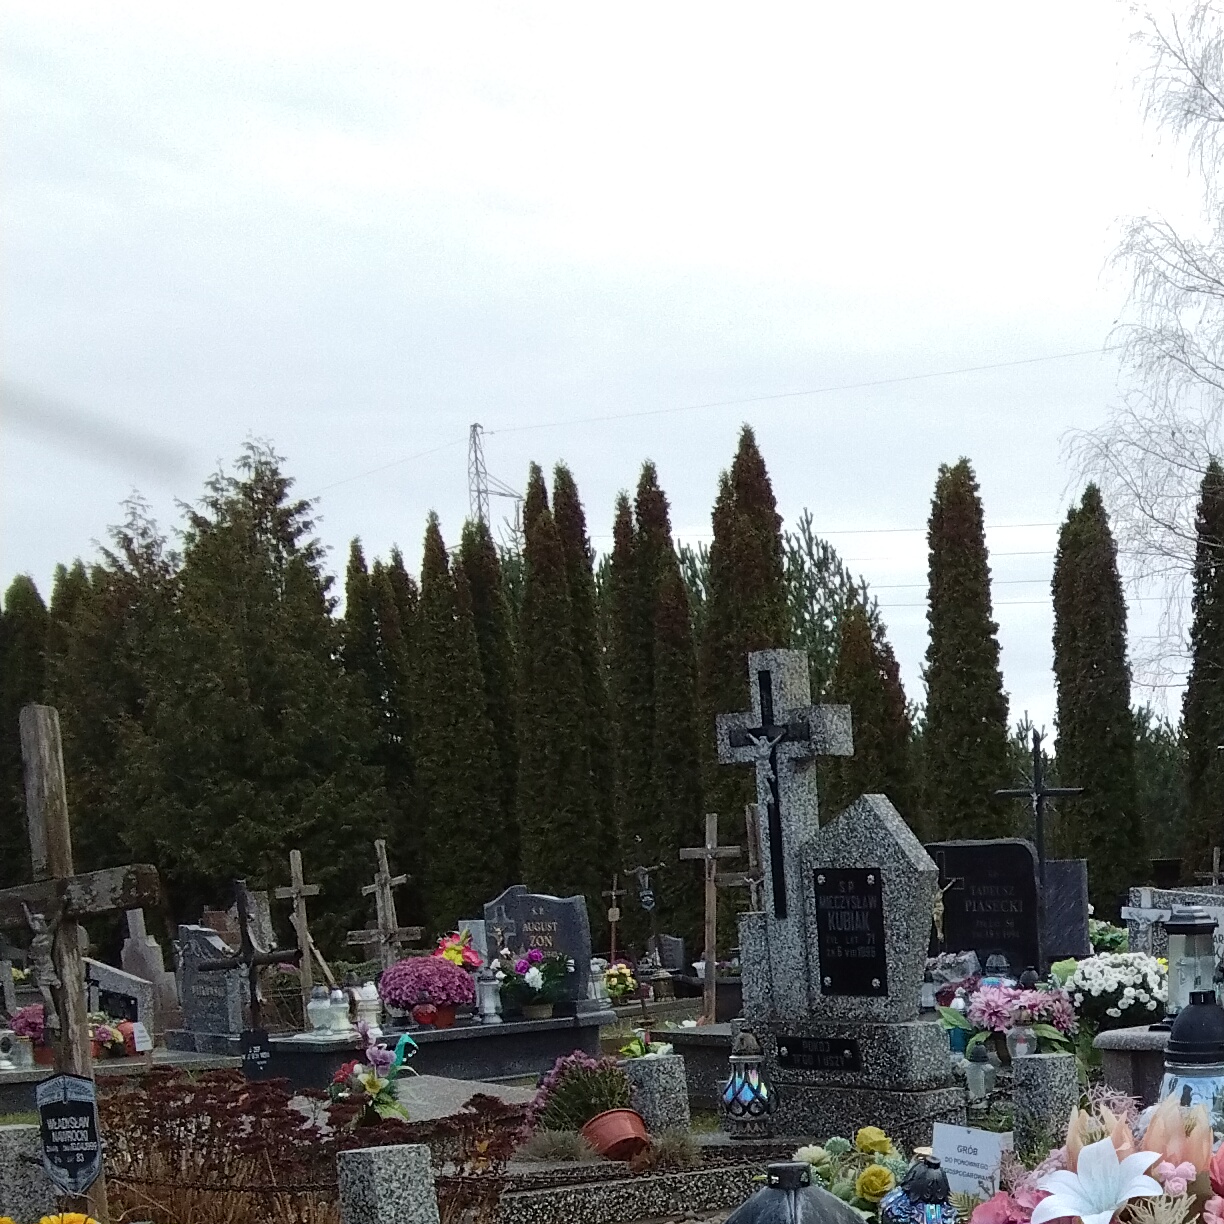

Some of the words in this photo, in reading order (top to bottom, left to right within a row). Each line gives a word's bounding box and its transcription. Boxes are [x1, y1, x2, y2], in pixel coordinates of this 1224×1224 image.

[965, 900, 1024, 912] PIASECKI
[522, 921, 558, 932] AUGUST
[827, 910, 870, 931] KUBIAK
[956, 1144, 979, 1156] GRÓB
